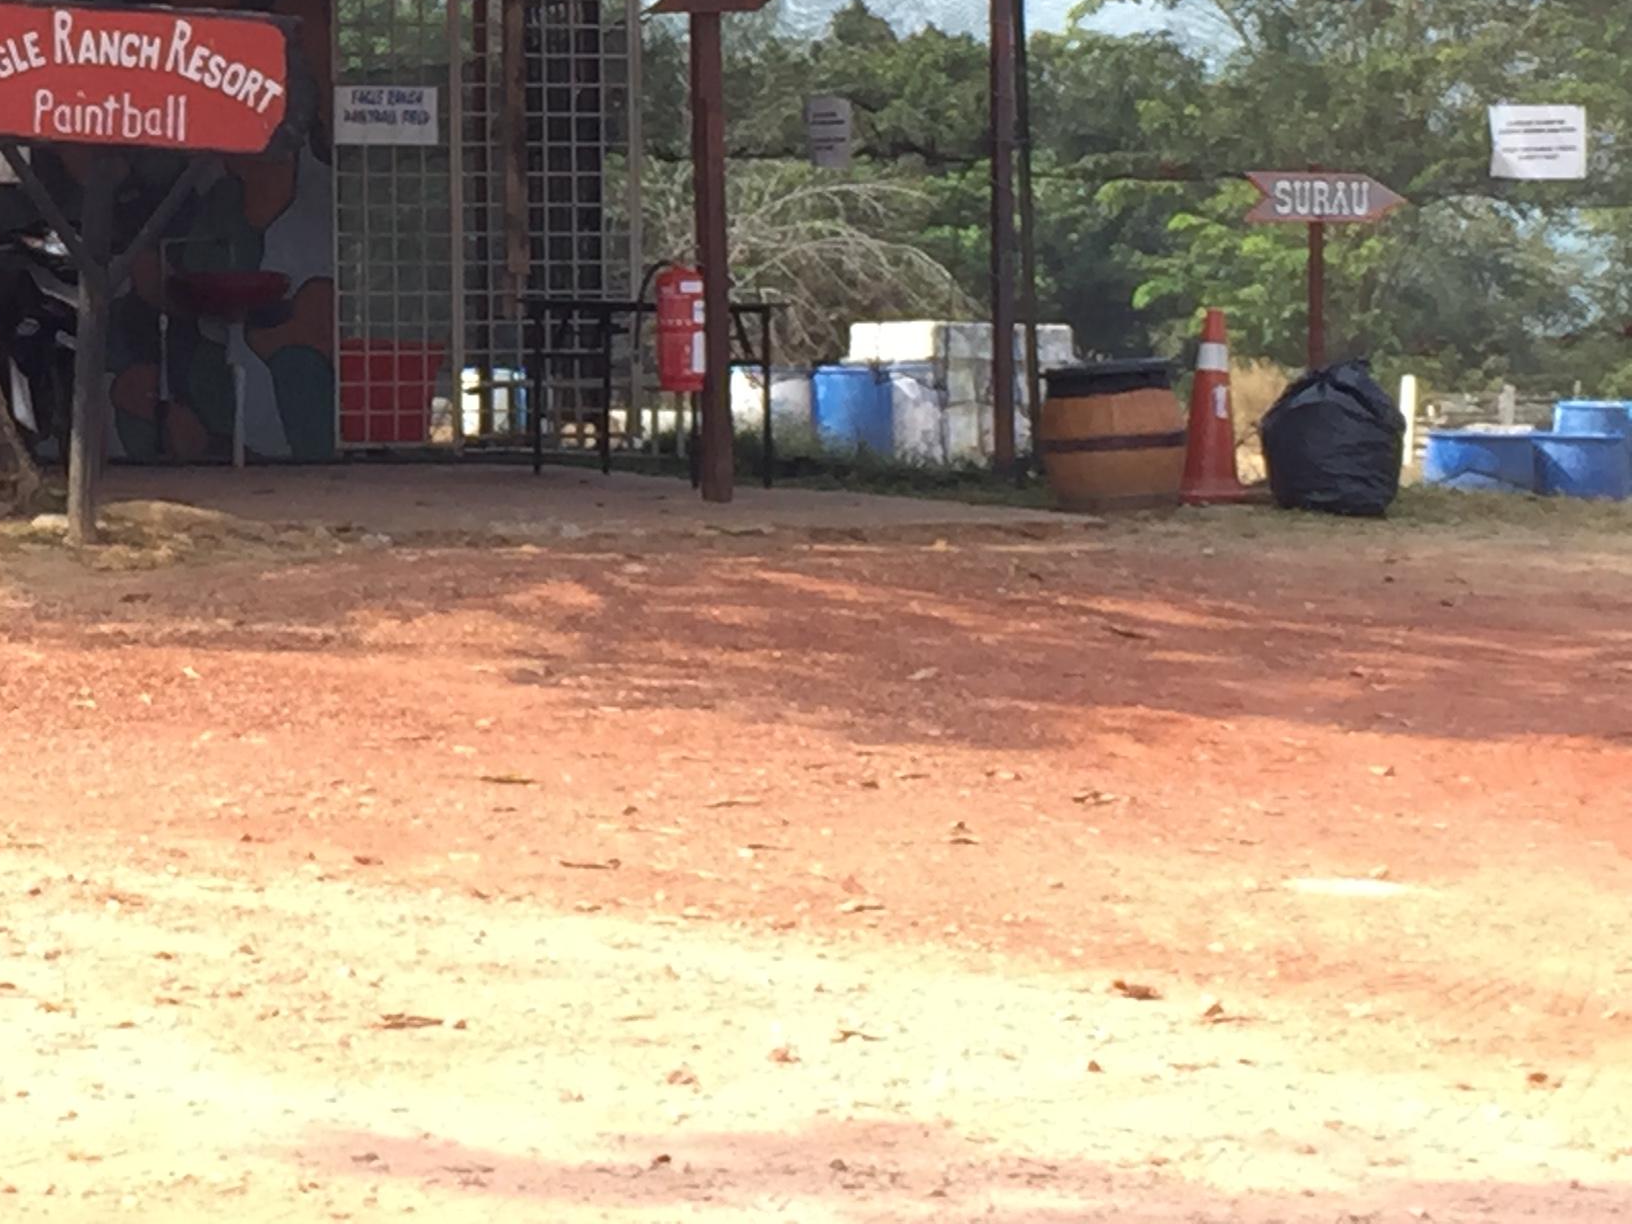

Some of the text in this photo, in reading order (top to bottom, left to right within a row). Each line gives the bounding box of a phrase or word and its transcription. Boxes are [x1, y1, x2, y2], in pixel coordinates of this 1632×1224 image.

[53, 9, 161, 71] RANCH
[165, 19, 284, 114] RESORT
[33, 88, 187, 142] Paintball
[1274, 180, 1369, 215] SURAU
